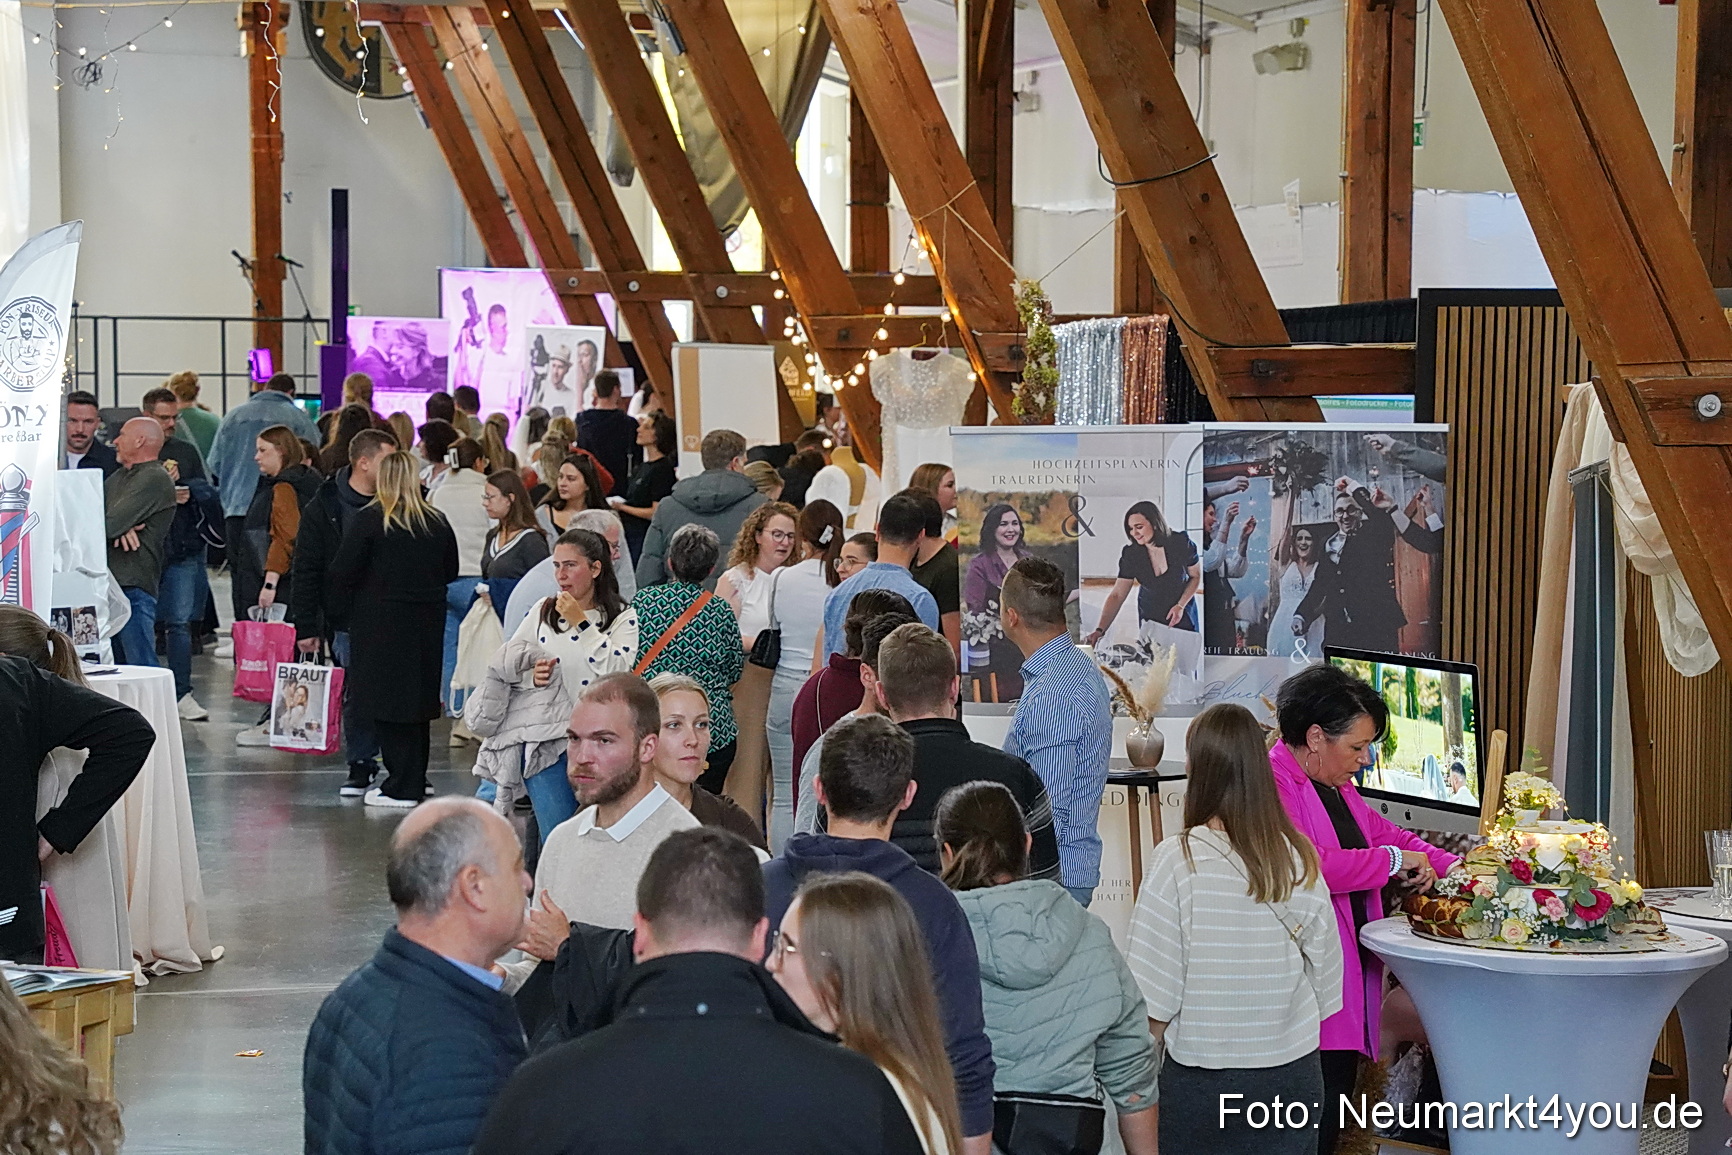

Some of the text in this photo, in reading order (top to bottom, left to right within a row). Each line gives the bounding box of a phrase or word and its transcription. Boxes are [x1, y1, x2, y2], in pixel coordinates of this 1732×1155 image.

[1032, 459, 1181, 470] HOCHZEITSPLANERIN
[992, 474, 1097, 486] TRAUREDNERIN
[1061, 494, 1096, 538] &
[1290, 637, 1312, 664] &
[277, 666, 329, 683] BRAUT
